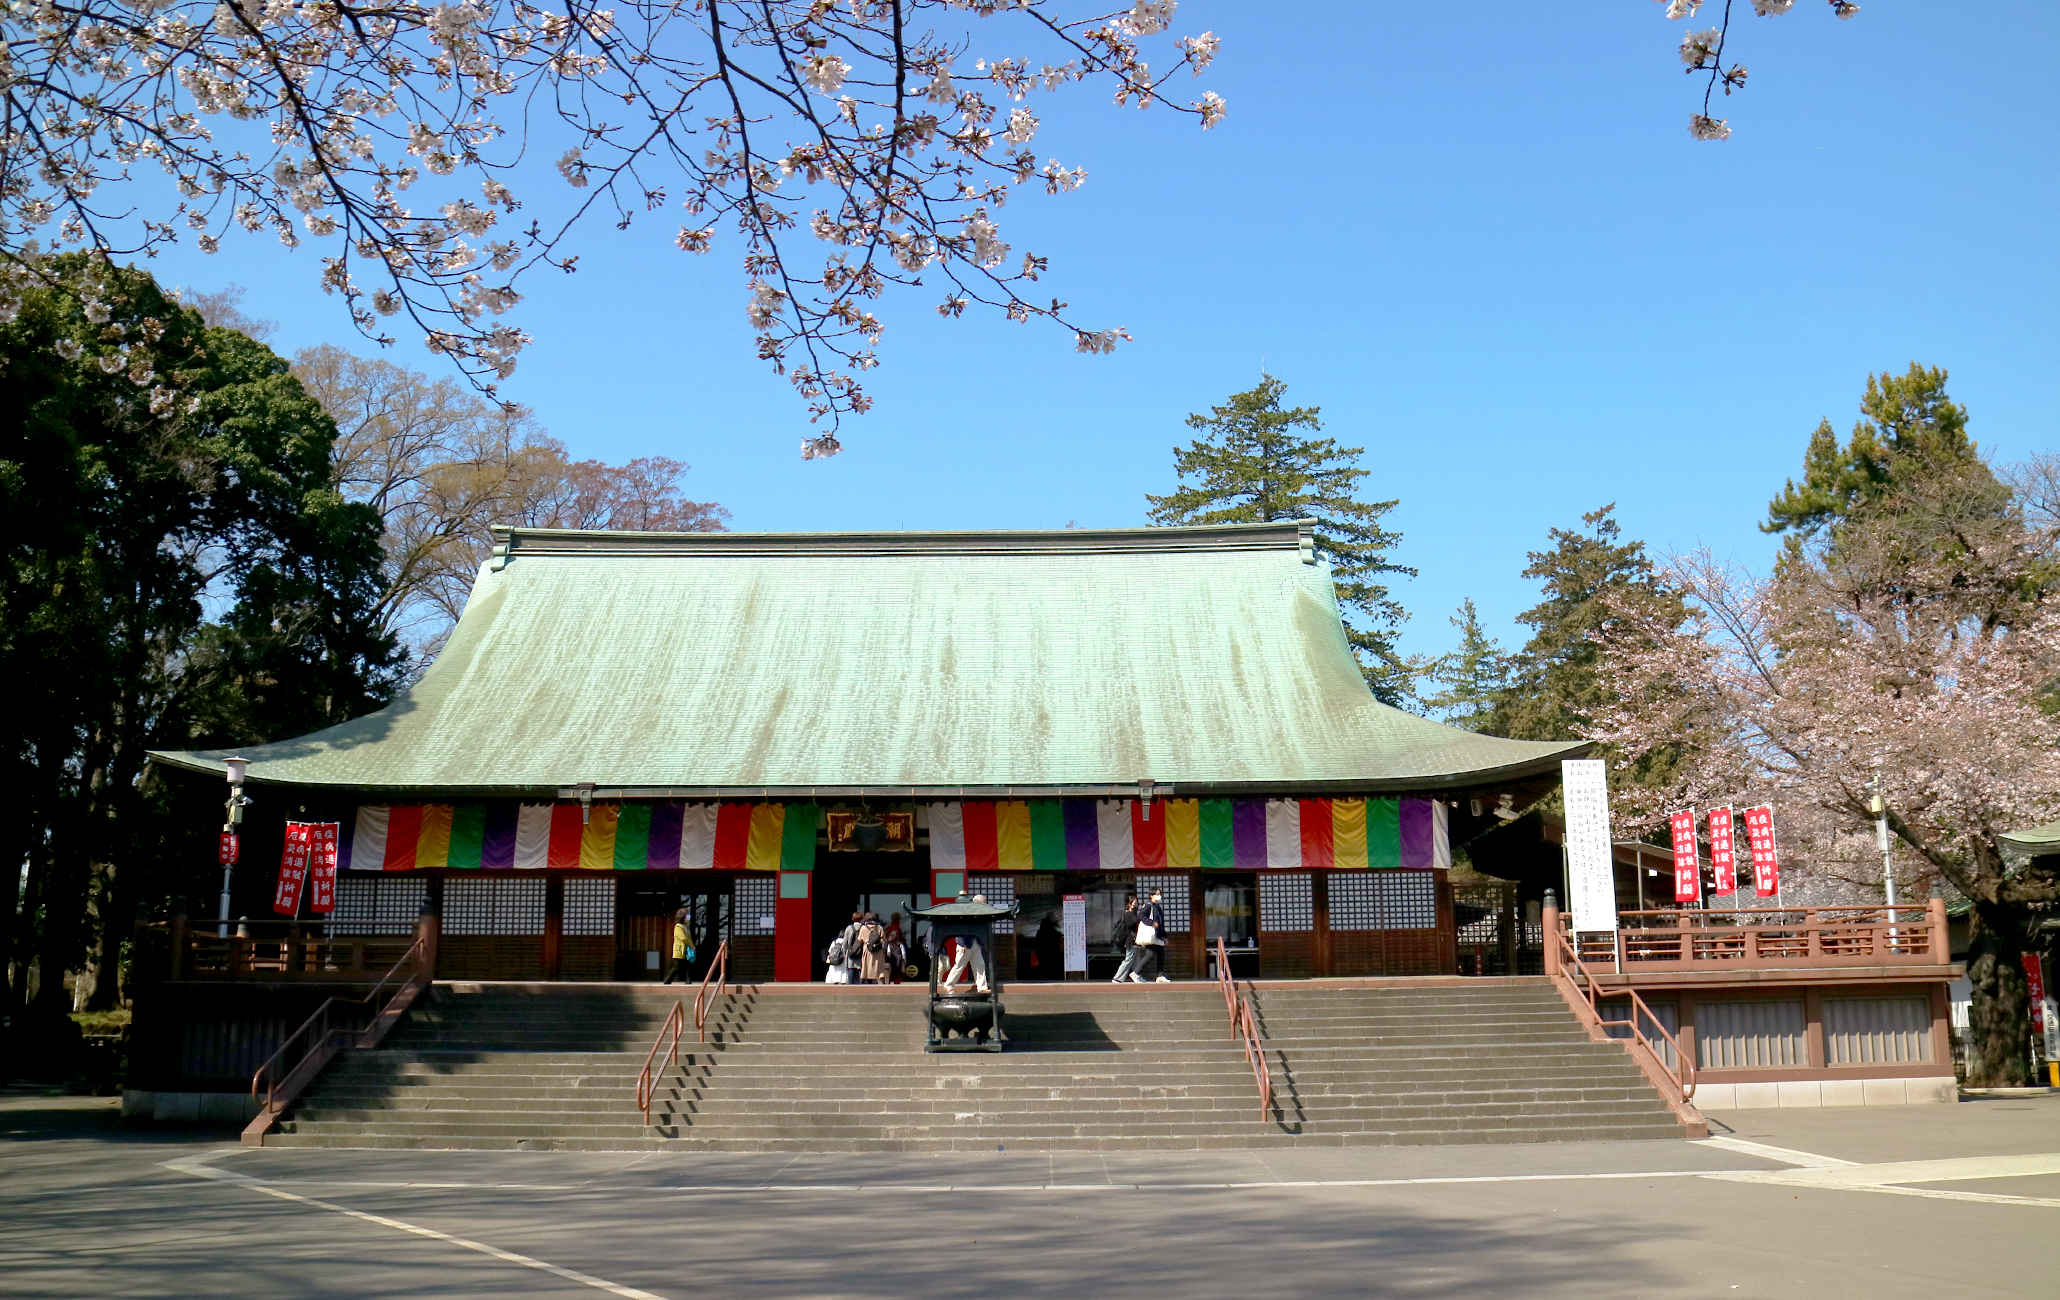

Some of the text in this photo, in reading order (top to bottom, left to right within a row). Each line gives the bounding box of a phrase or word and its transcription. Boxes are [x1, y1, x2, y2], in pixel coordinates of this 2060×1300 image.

[282, 831, 298, 879] 厄災消除
[313, 830, 324, 877] 厄災消除
[1675, 820, 1686, 867] 厄災消除
[1749, 815, 1764, 862] 厄災消除
